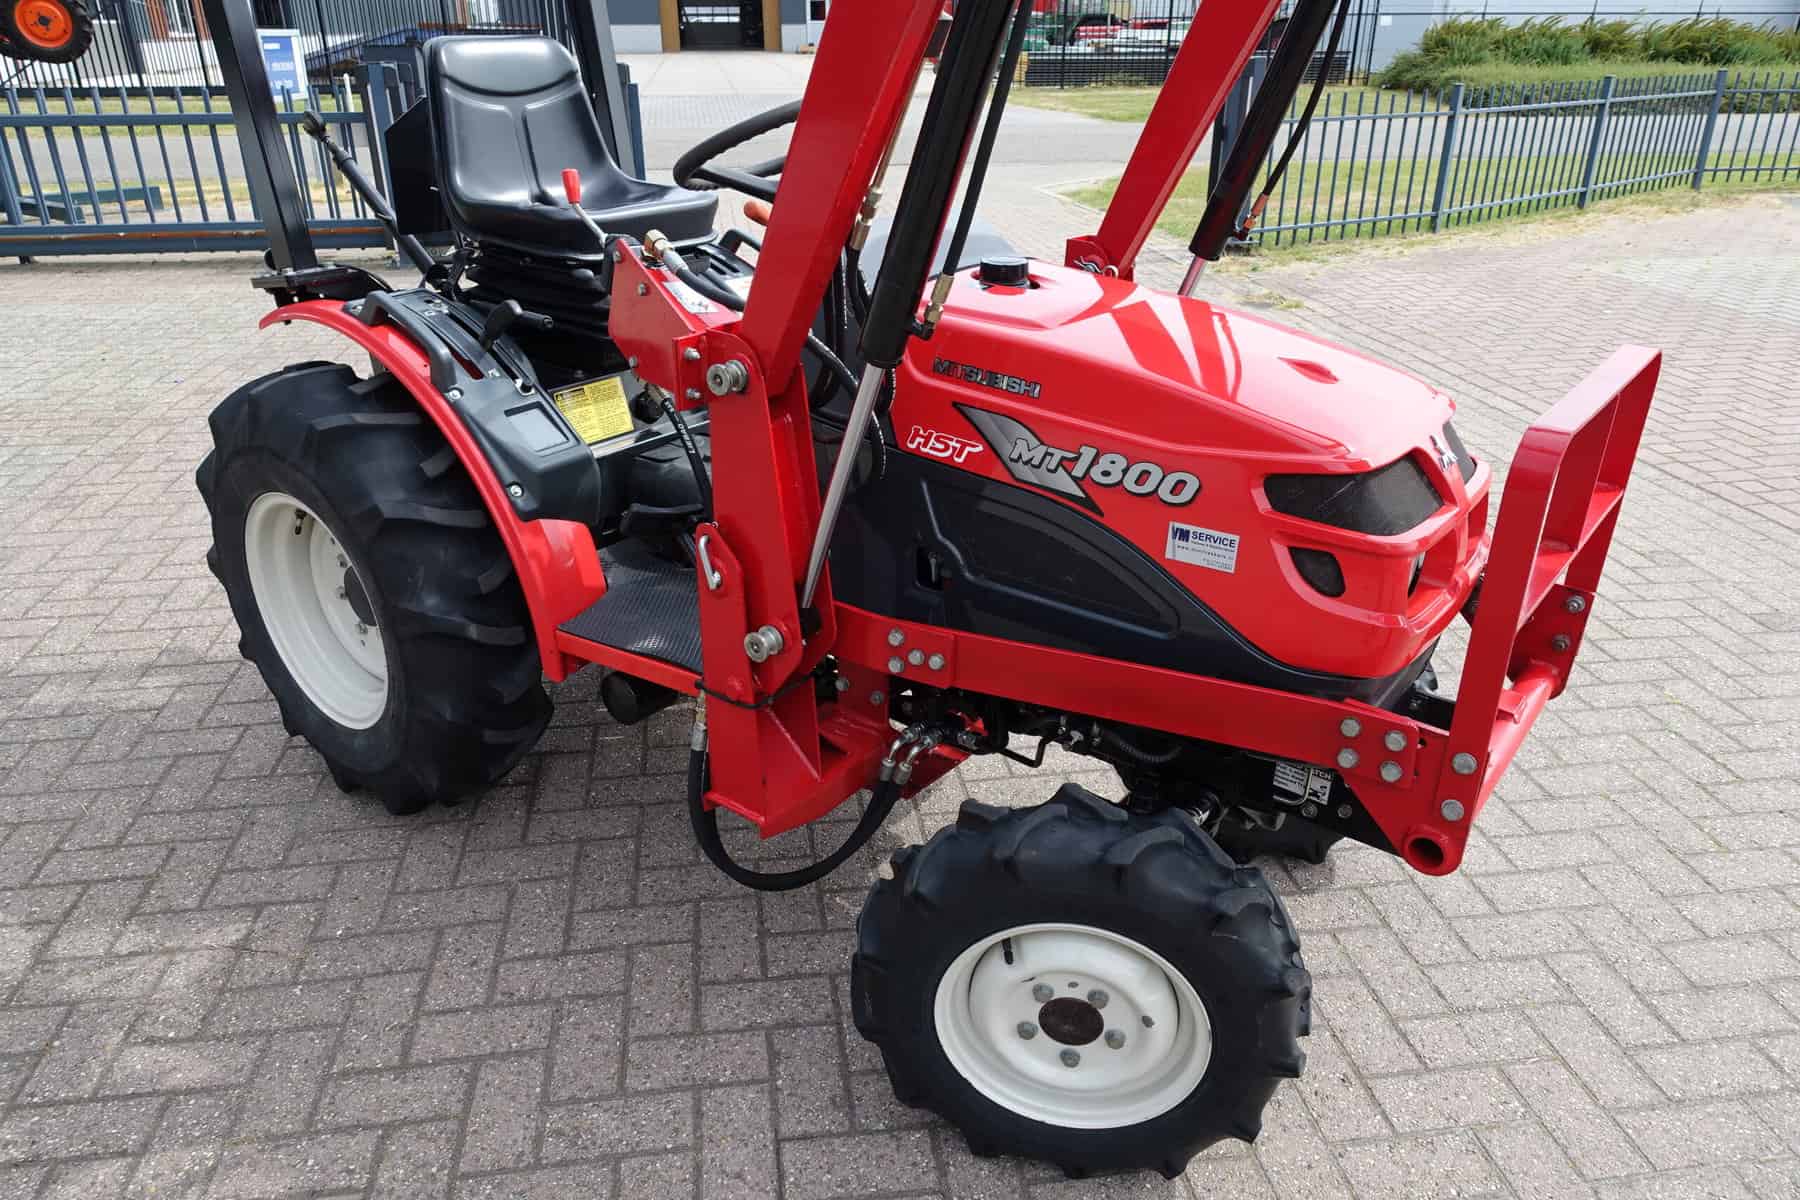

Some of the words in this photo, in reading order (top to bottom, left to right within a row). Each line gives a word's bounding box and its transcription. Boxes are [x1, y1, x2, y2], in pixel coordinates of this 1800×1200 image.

[933, 358, 1041, 399] MITSUBISHI
[906, 425, 983, 463] HST
[1008, 438, 1202, 505] MT1800
[1191, 530, 1236, 548] SERVICE
